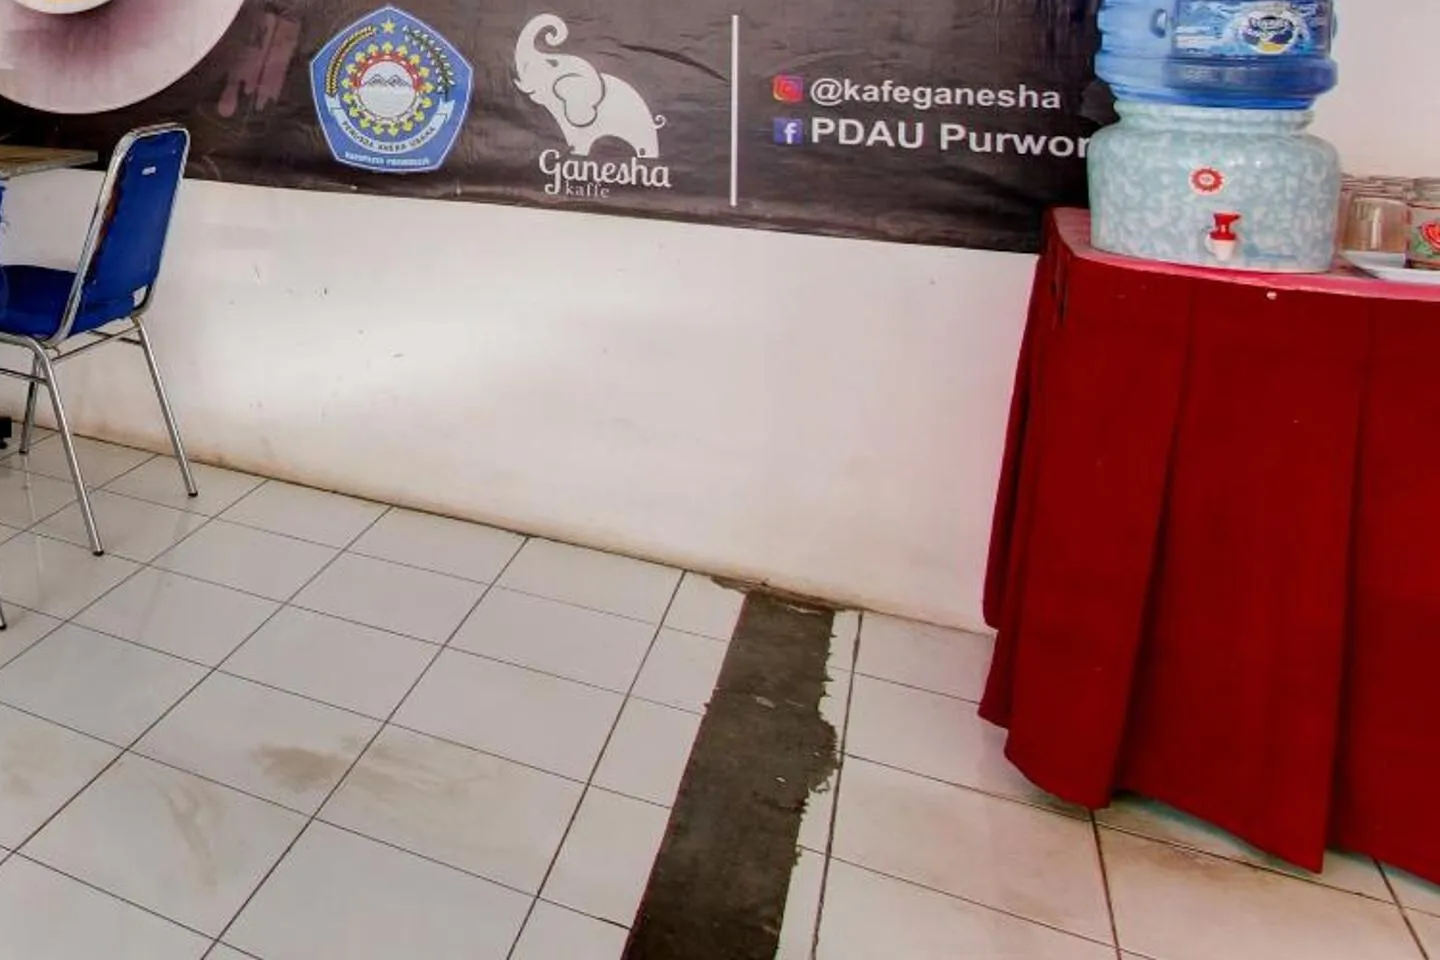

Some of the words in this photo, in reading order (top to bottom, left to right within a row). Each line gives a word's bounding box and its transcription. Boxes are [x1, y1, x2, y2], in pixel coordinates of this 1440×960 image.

[810, 77, 1062, 110] @kafeganesha
[810, 116, 926, 150] PDAU
[939, 122, 1091, 159] Purwor
[538, 148, 673, 196] Ganesha
[564, 180, 610, 199] kaffe
